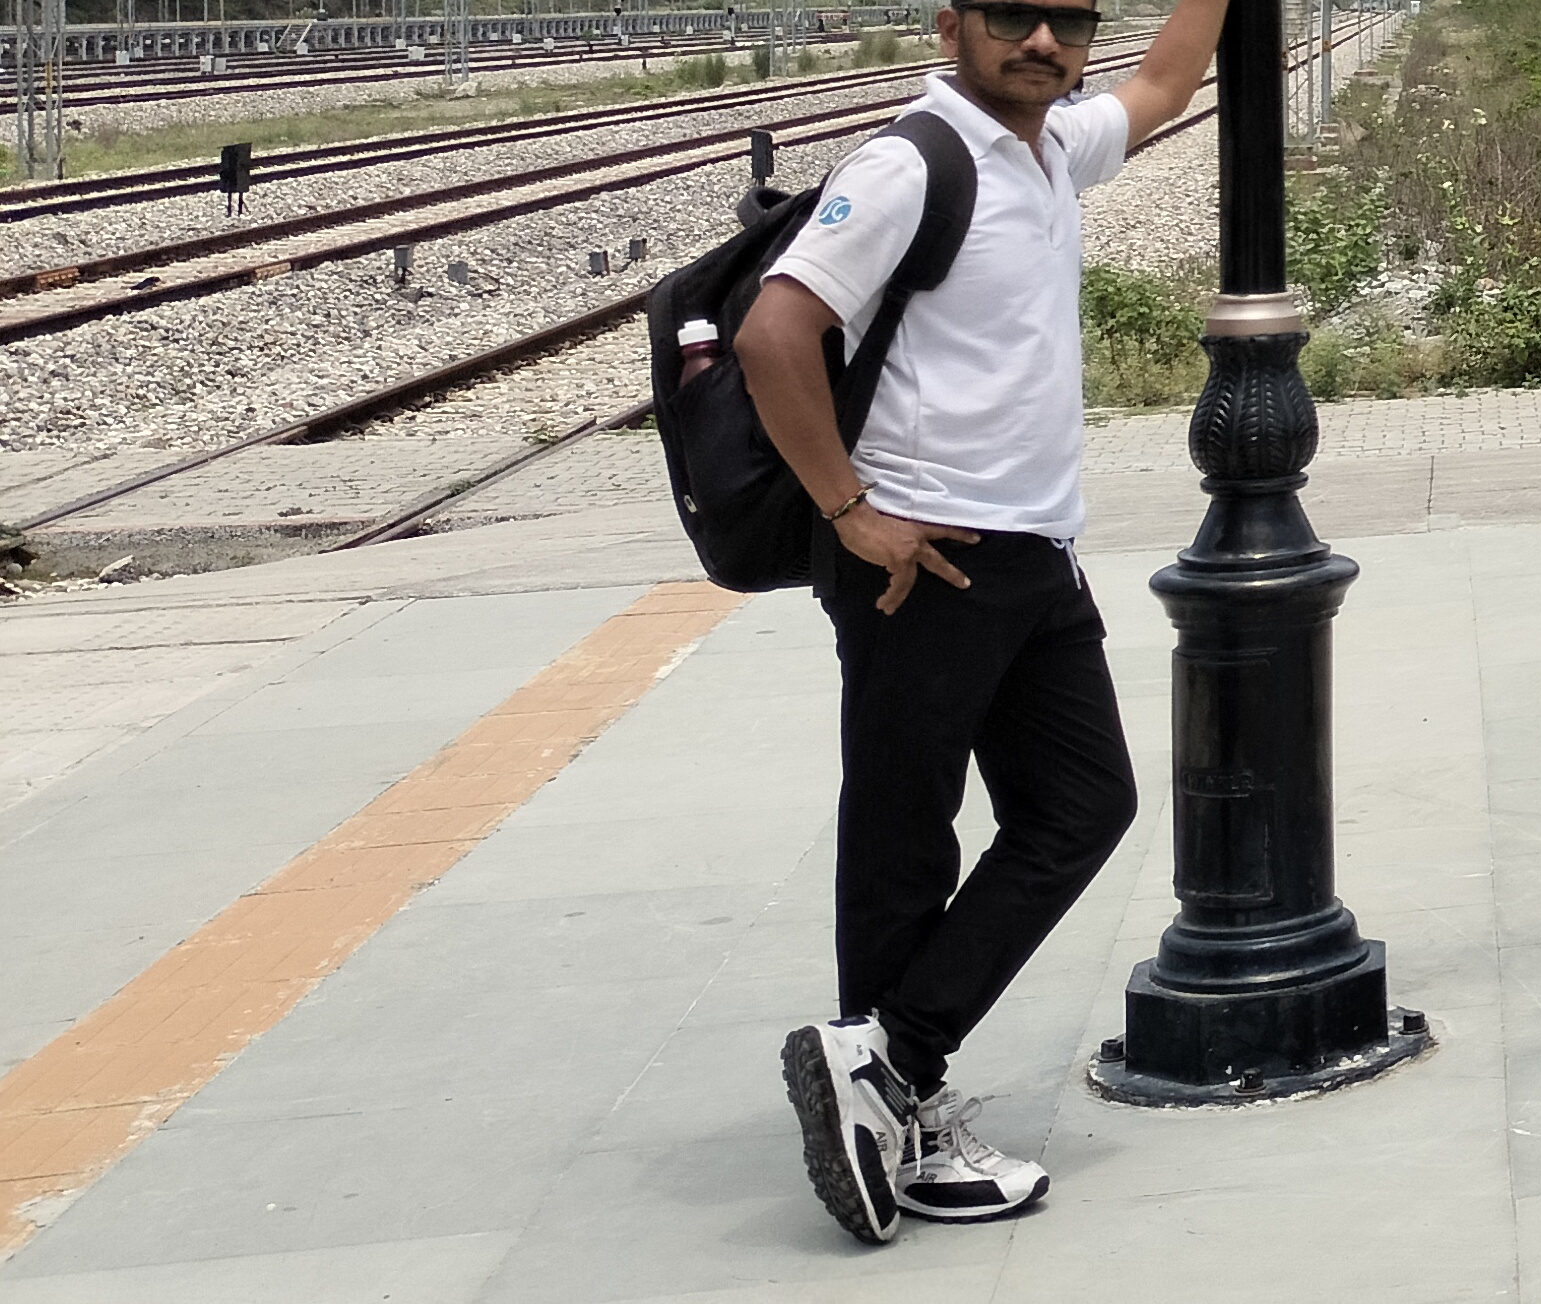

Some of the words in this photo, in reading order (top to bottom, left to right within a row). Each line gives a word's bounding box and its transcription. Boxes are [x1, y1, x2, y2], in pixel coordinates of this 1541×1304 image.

[856, 1044, 864, 1057] AIR
[875, 1130, 889, 1154] AIR
[916, 1169, 939, 1184] AIR
